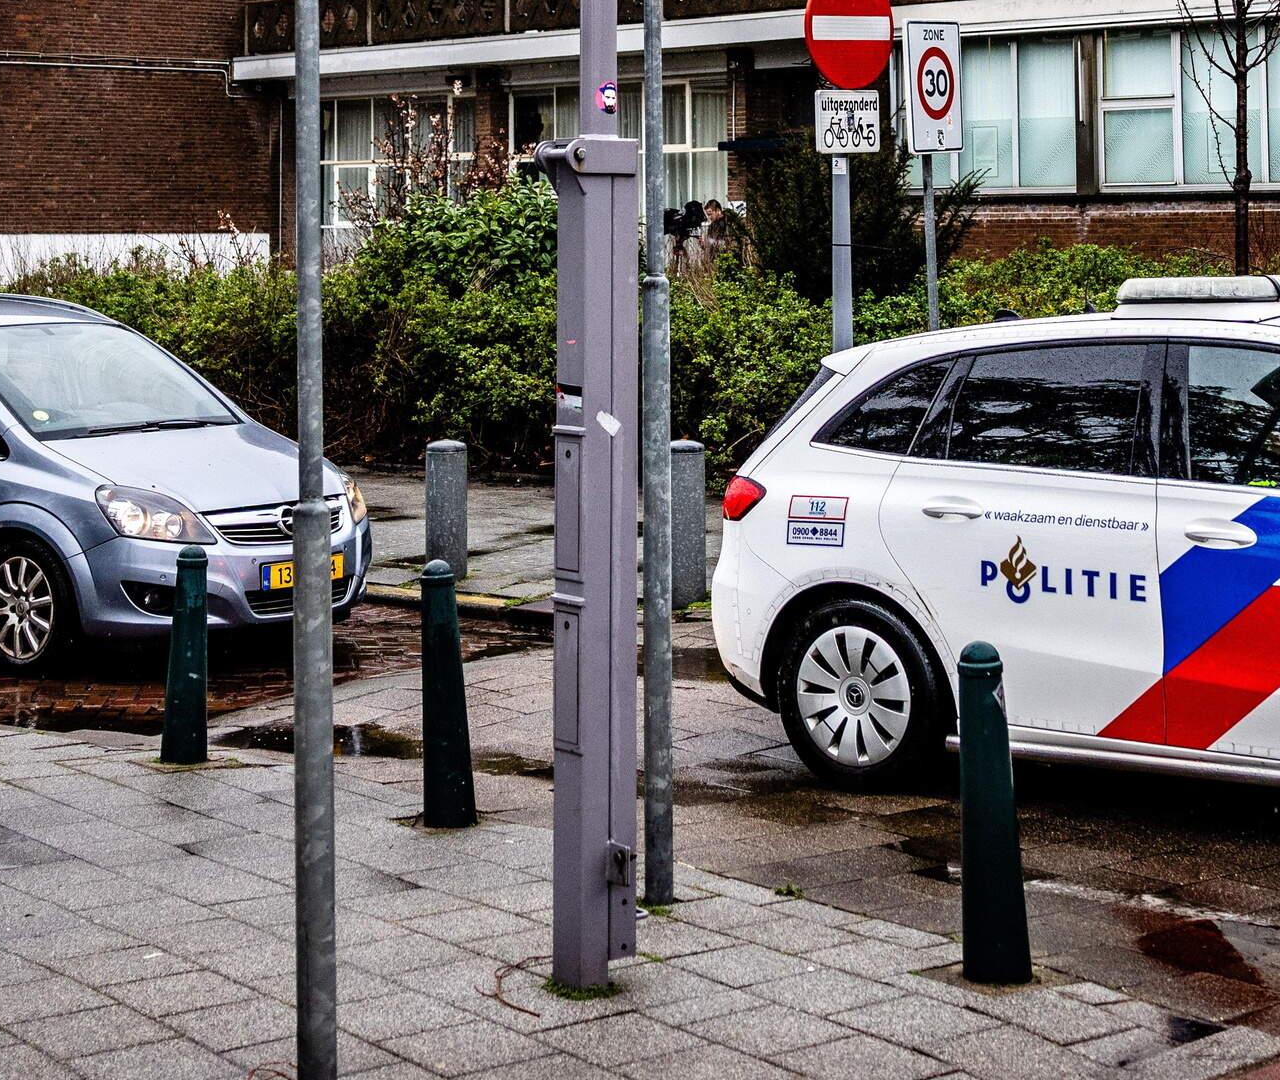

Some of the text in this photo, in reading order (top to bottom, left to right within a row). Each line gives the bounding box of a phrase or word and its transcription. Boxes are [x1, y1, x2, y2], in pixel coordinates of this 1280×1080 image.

[923, 29, 945, 41] ZONE
[924, 69, 948, 98] 30
[821, 96, 878, 116] uitgezonderd
[994, 510, 1056, 525] waakzaam
[1058, 516, 1073, 526] en
[1074, 515, 1140, 531] dienstbaar
[793, 527, 837, 536] 0900 8844
[980, 560, 1147, 604] POLITIE
